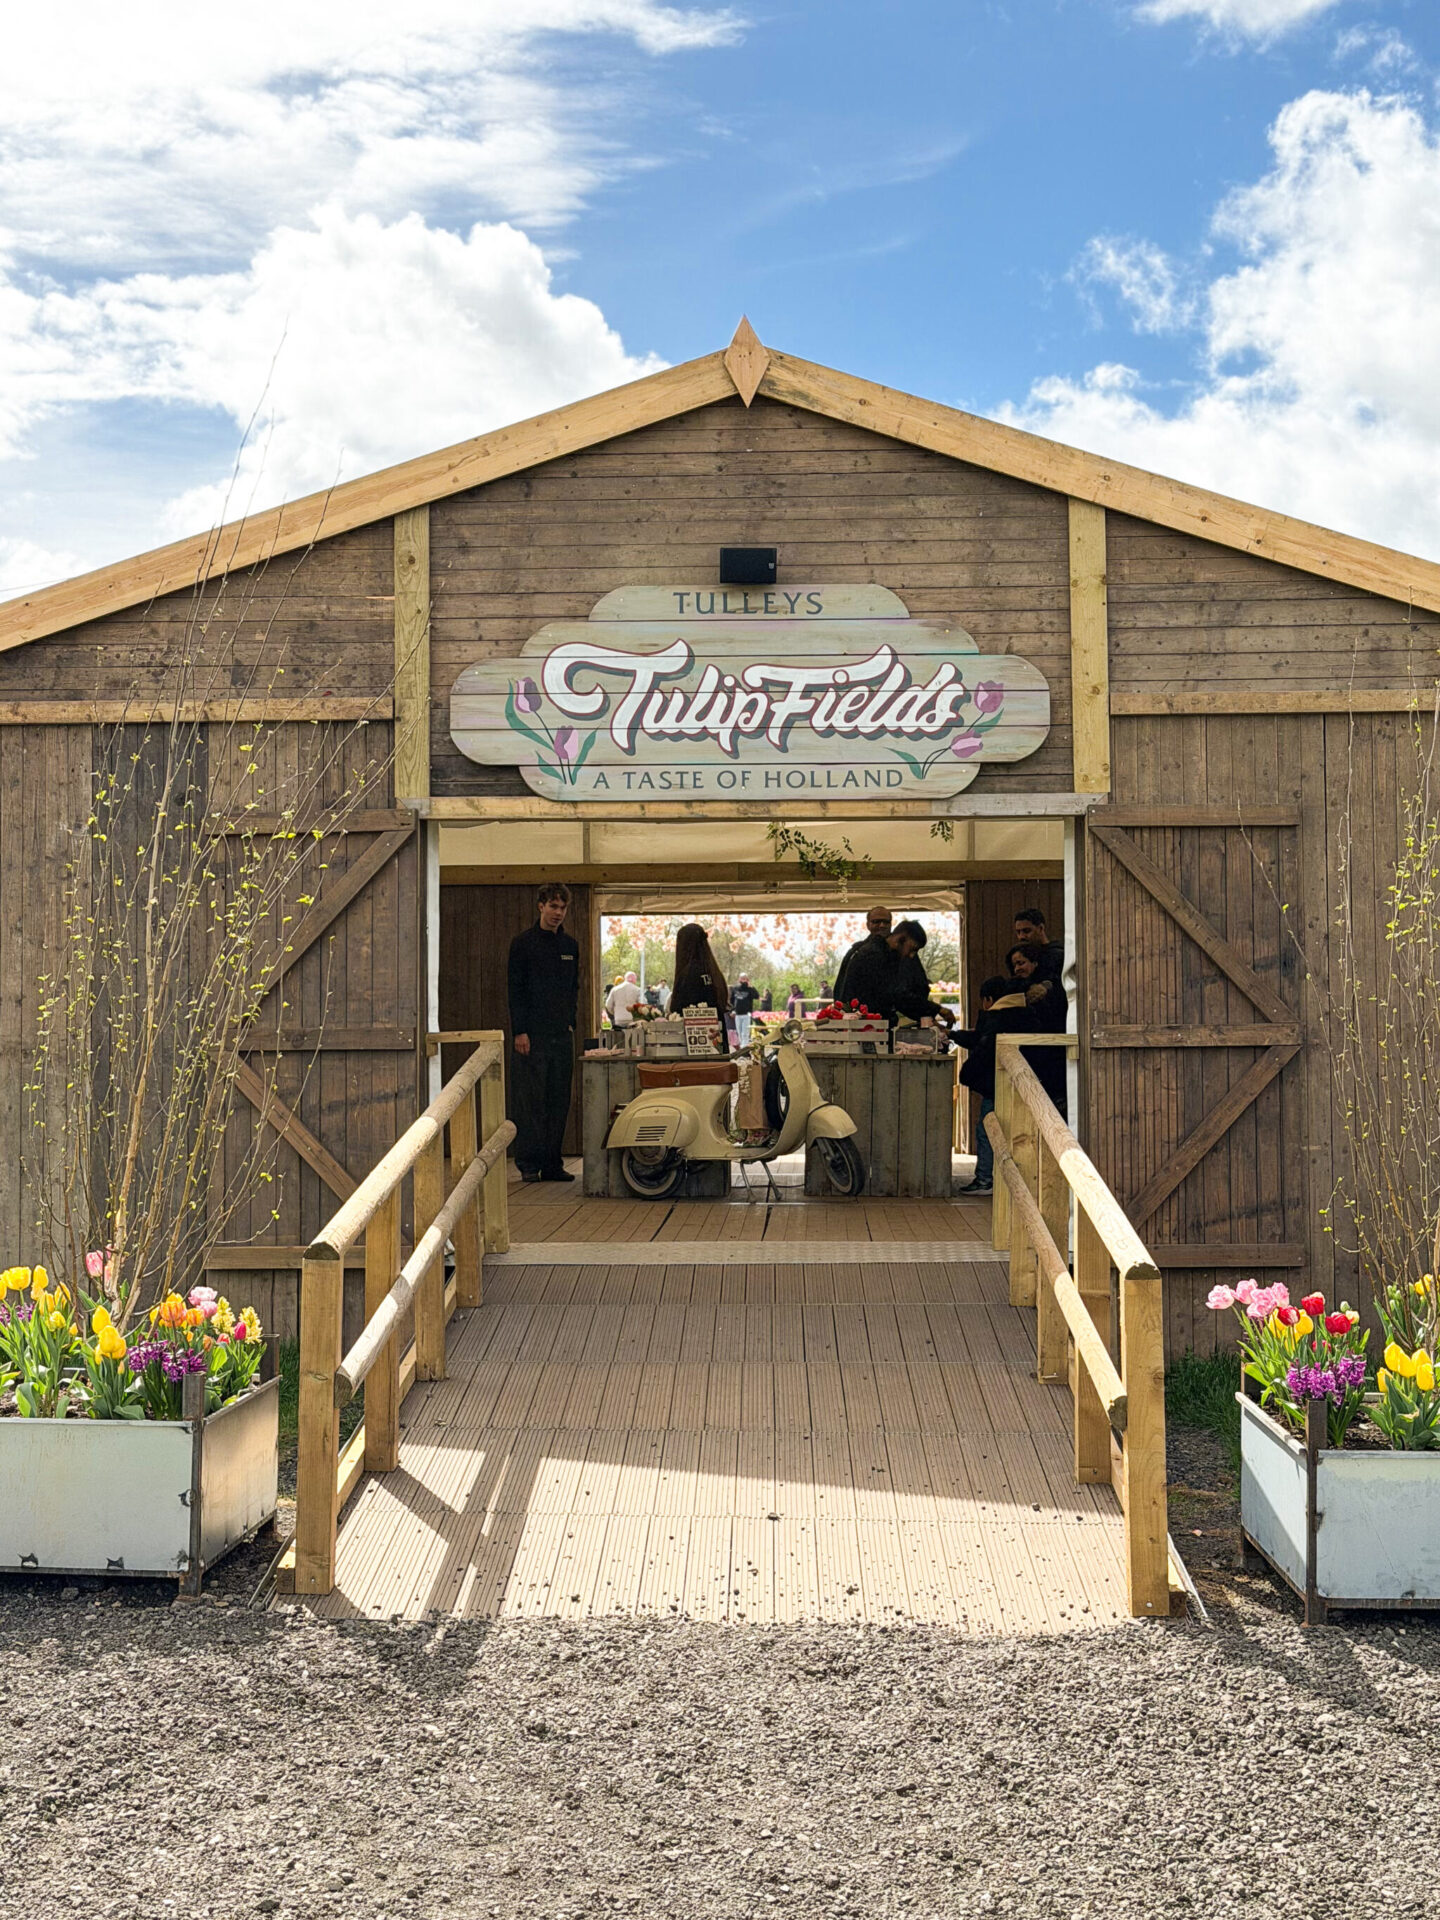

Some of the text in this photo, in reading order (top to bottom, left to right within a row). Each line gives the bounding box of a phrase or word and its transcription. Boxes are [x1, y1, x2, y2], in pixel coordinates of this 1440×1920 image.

[673, 591, 823, 614] TULLEYS
[593, 769, 904, 789] A TASTE OF HOLLAND
